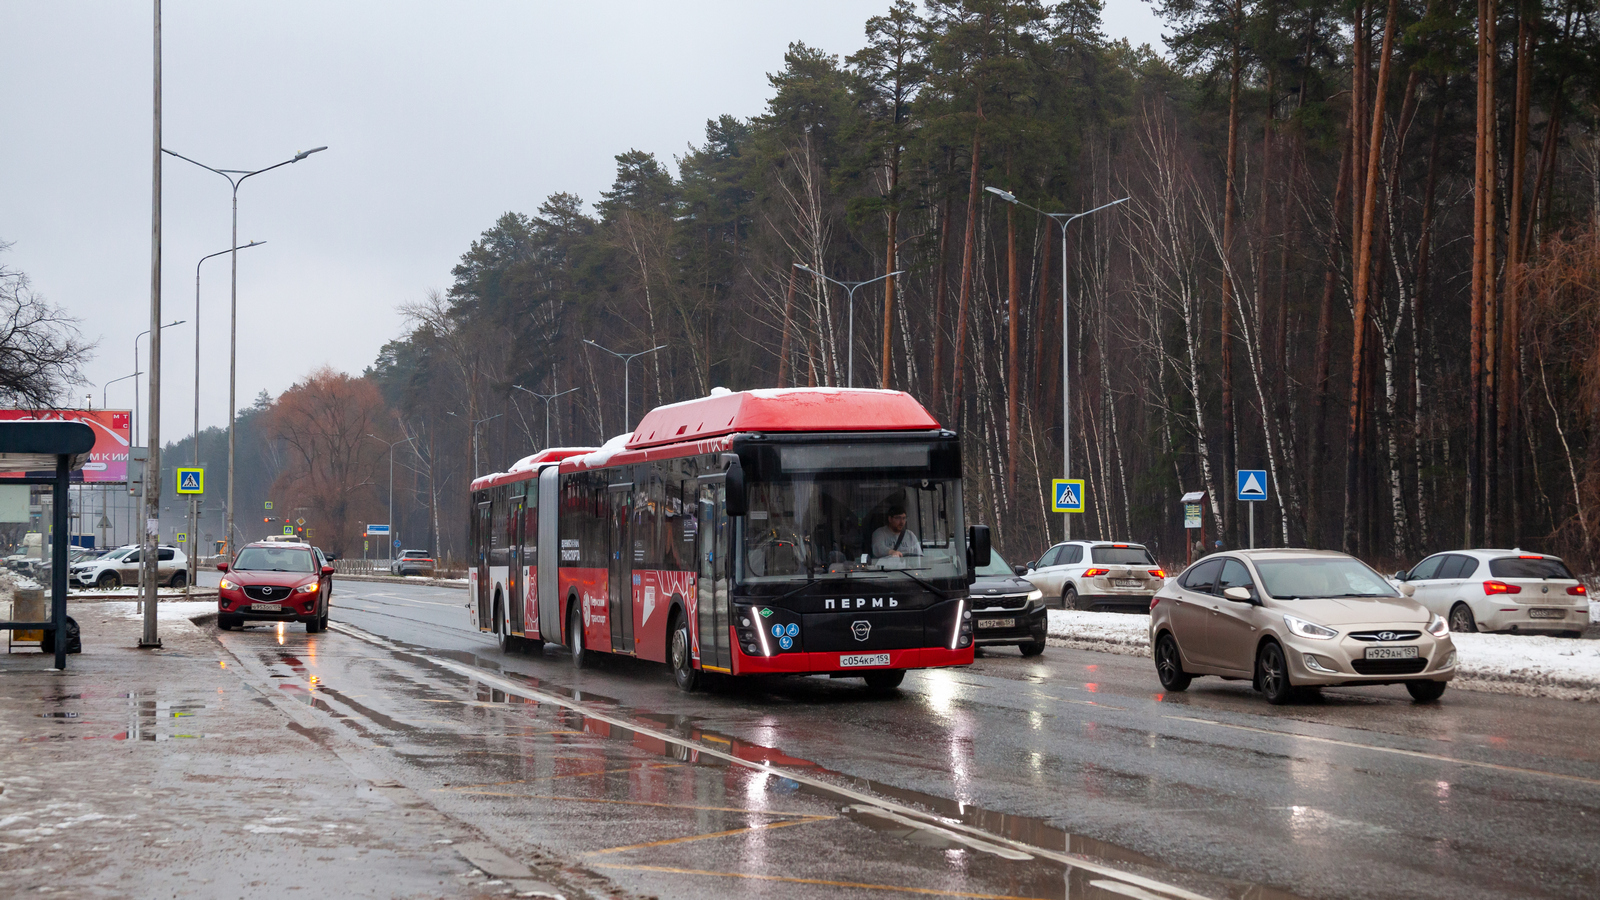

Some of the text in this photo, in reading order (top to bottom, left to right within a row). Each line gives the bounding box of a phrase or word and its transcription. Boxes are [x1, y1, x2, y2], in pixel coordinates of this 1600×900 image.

[825, 597, 899, 609] ПЕРМЬ
[1368, 648, 1416, 658] Н929АН 159
[842, 654, 889, 666] С054КР 159
